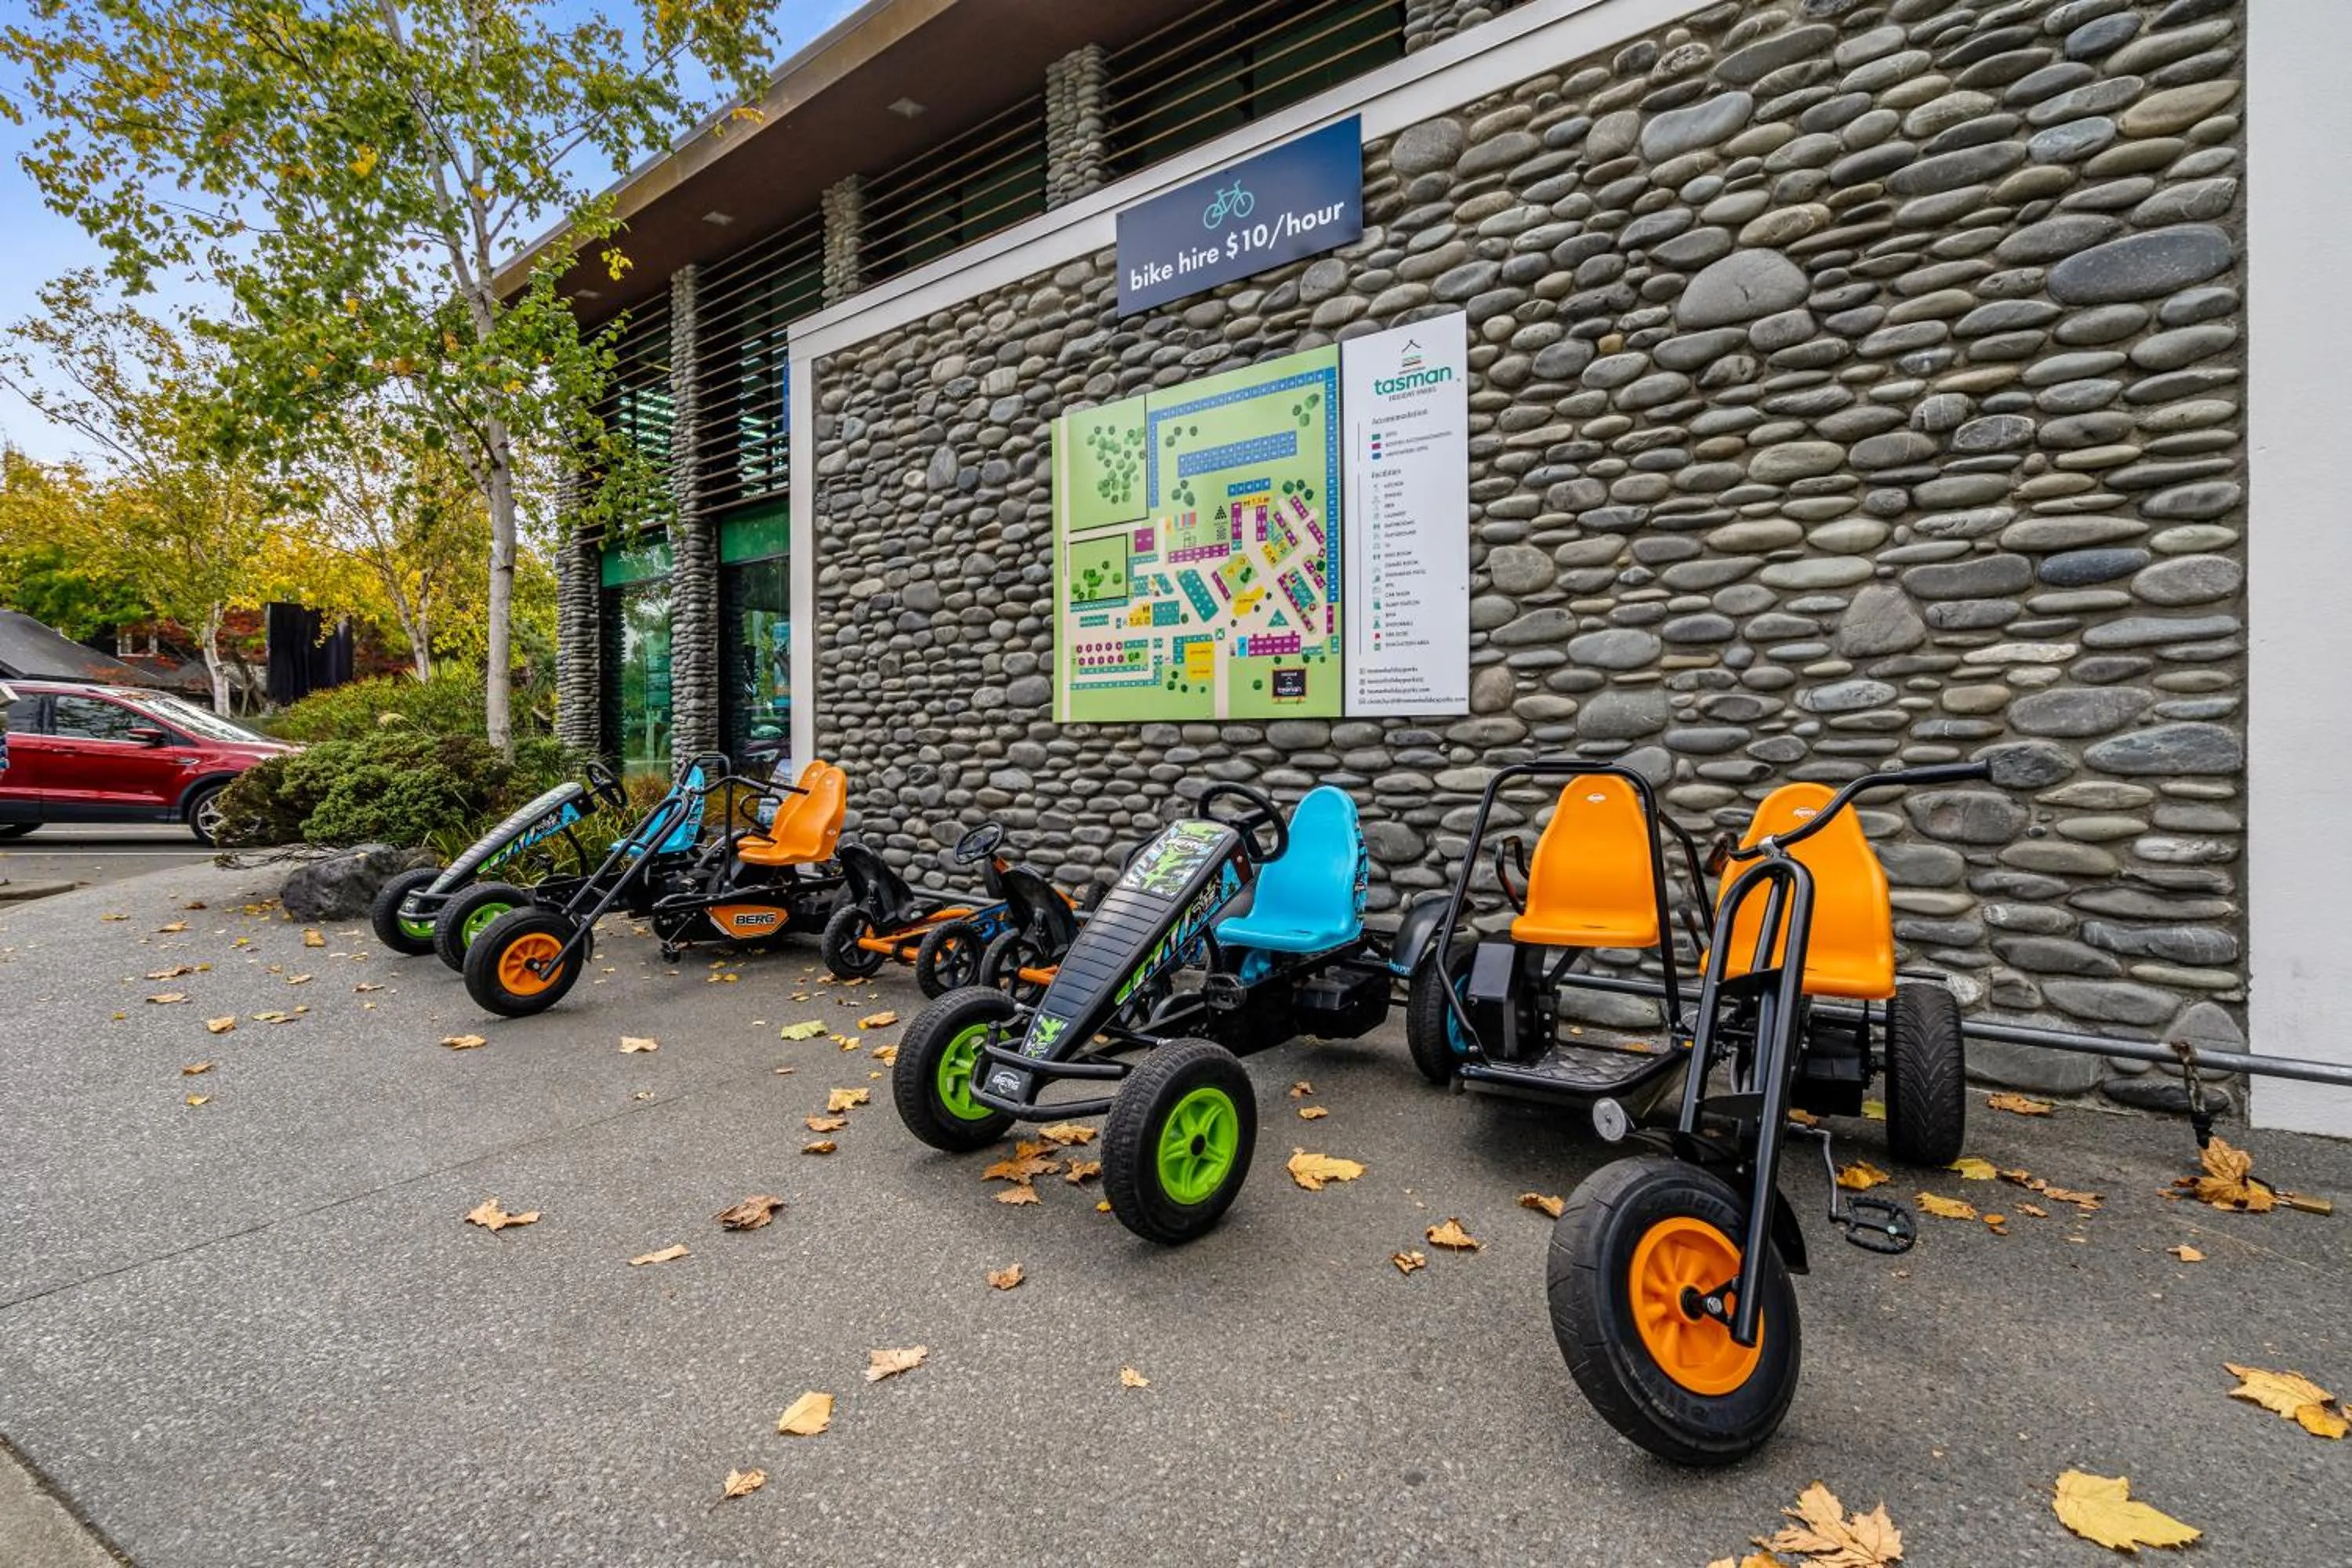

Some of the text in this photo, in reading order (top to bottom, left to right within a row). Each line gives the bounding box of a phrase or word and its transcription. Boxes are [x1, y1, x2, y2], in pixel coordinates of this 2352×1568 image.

[1131, 201, 1345, 292] bike hire $10/hour
[1374, 366, 1452, 395] tasman
[735, 913, 776, 925] BERG
[993, 1074, 1021, 1091] BERG
